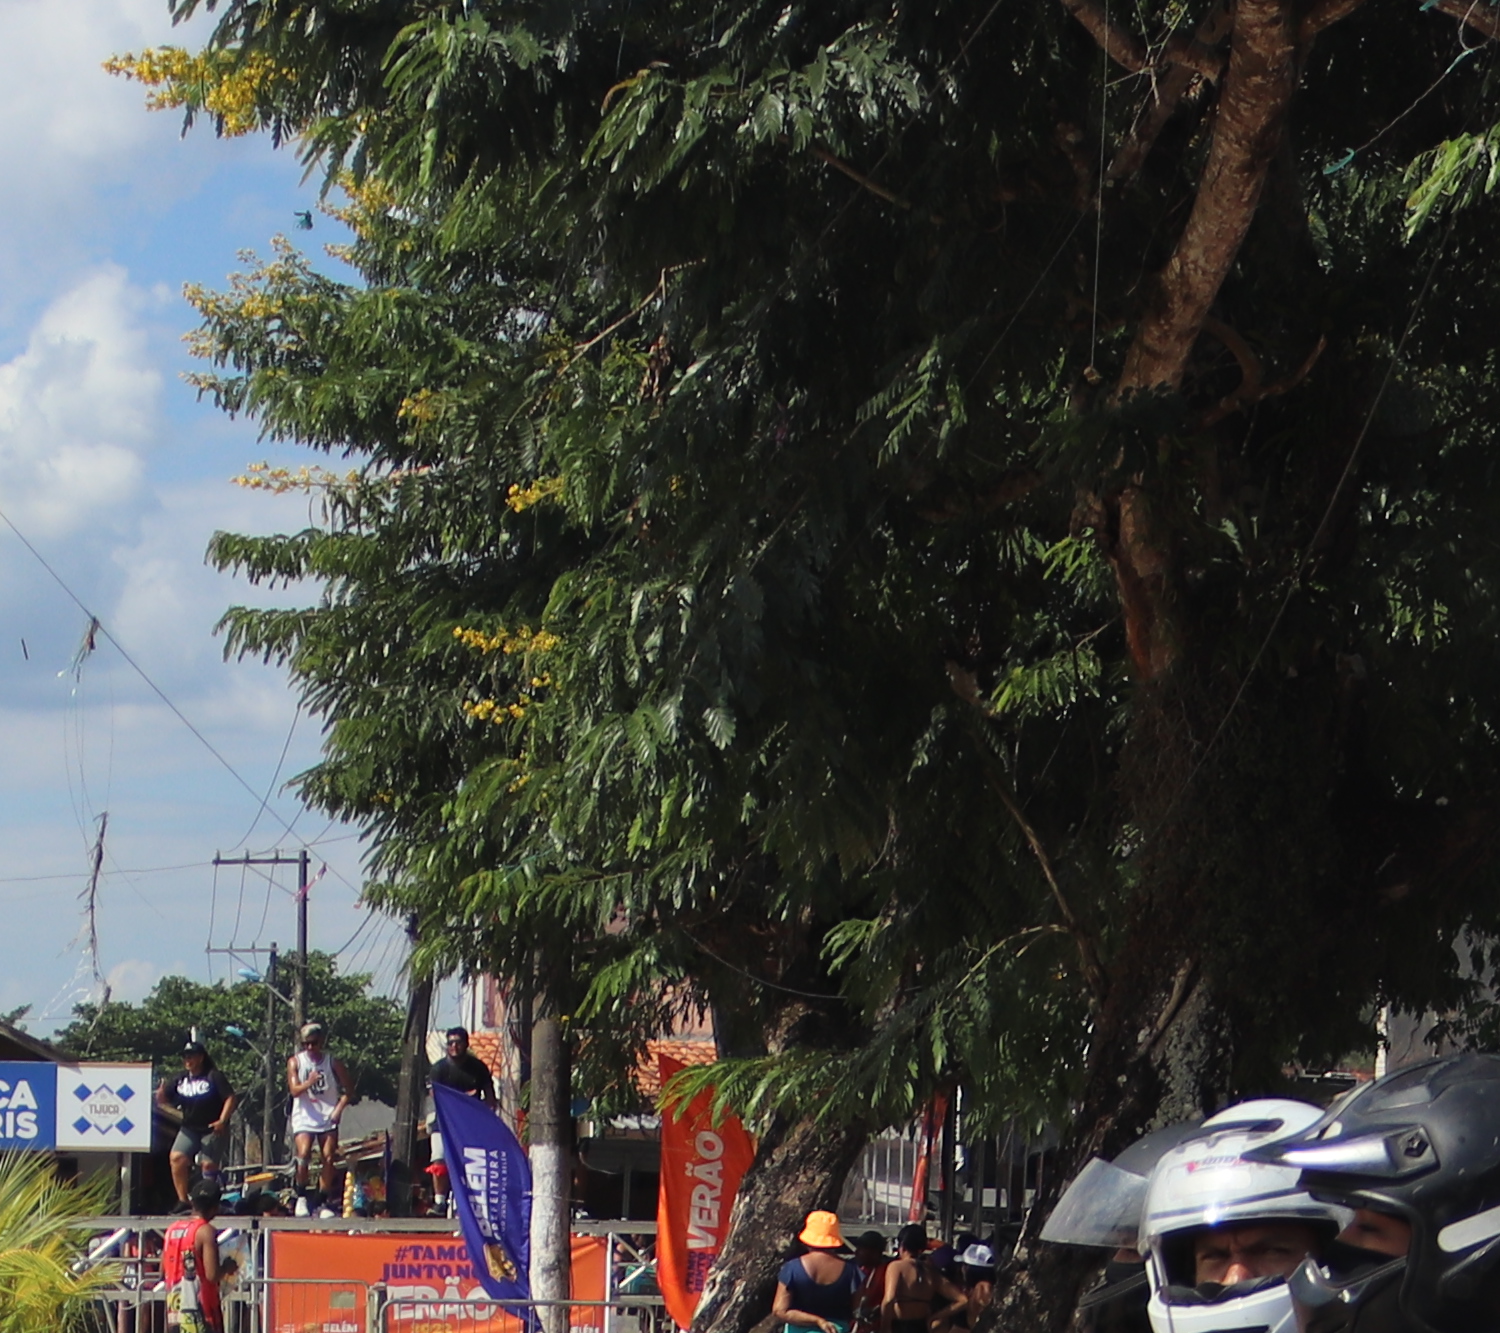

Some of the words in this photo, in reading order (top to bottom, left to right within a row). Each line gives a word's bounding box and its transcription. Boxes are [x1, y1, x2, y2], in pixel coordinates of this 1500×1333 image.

[461, 1147, 492, 1238] BELÉM
[685, 1131, 724, 1249] VERÃO
[383, 1263, 453, 1281] JUNTO
